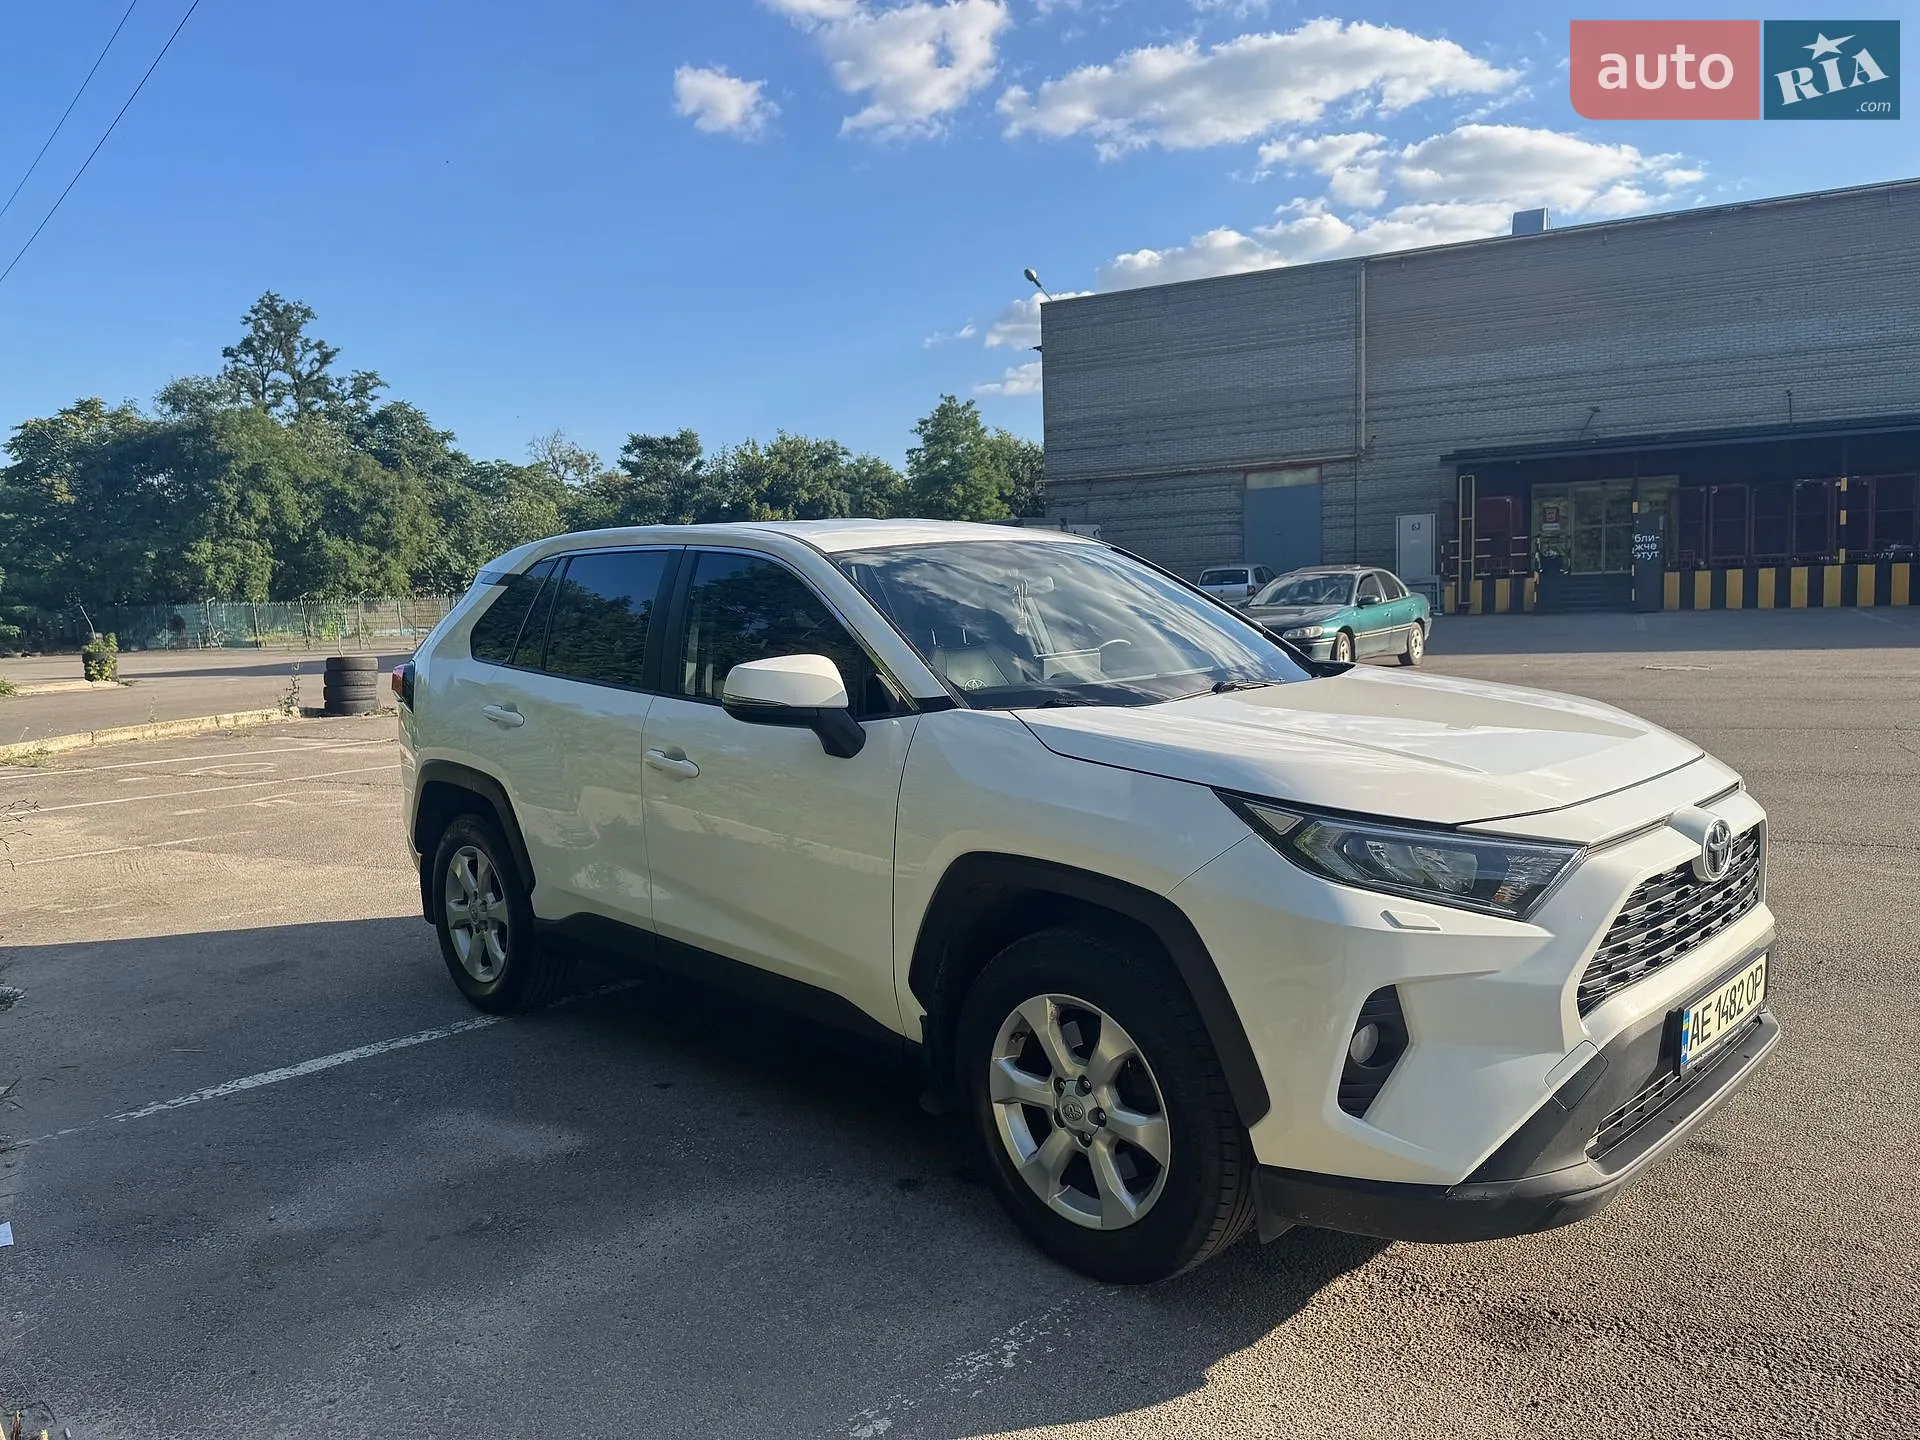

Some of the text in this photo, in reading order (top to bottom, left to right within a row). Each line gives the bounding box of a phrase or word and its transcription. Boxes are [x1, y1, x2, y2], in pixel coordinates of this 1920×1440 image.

[1634, 533, 1660, 543] бли-
[1634, 542, 1657, 551] жче
[1640, 550, 1659, 560] тут
[1689, 964, 1763, 1051] AE 1482 OP
